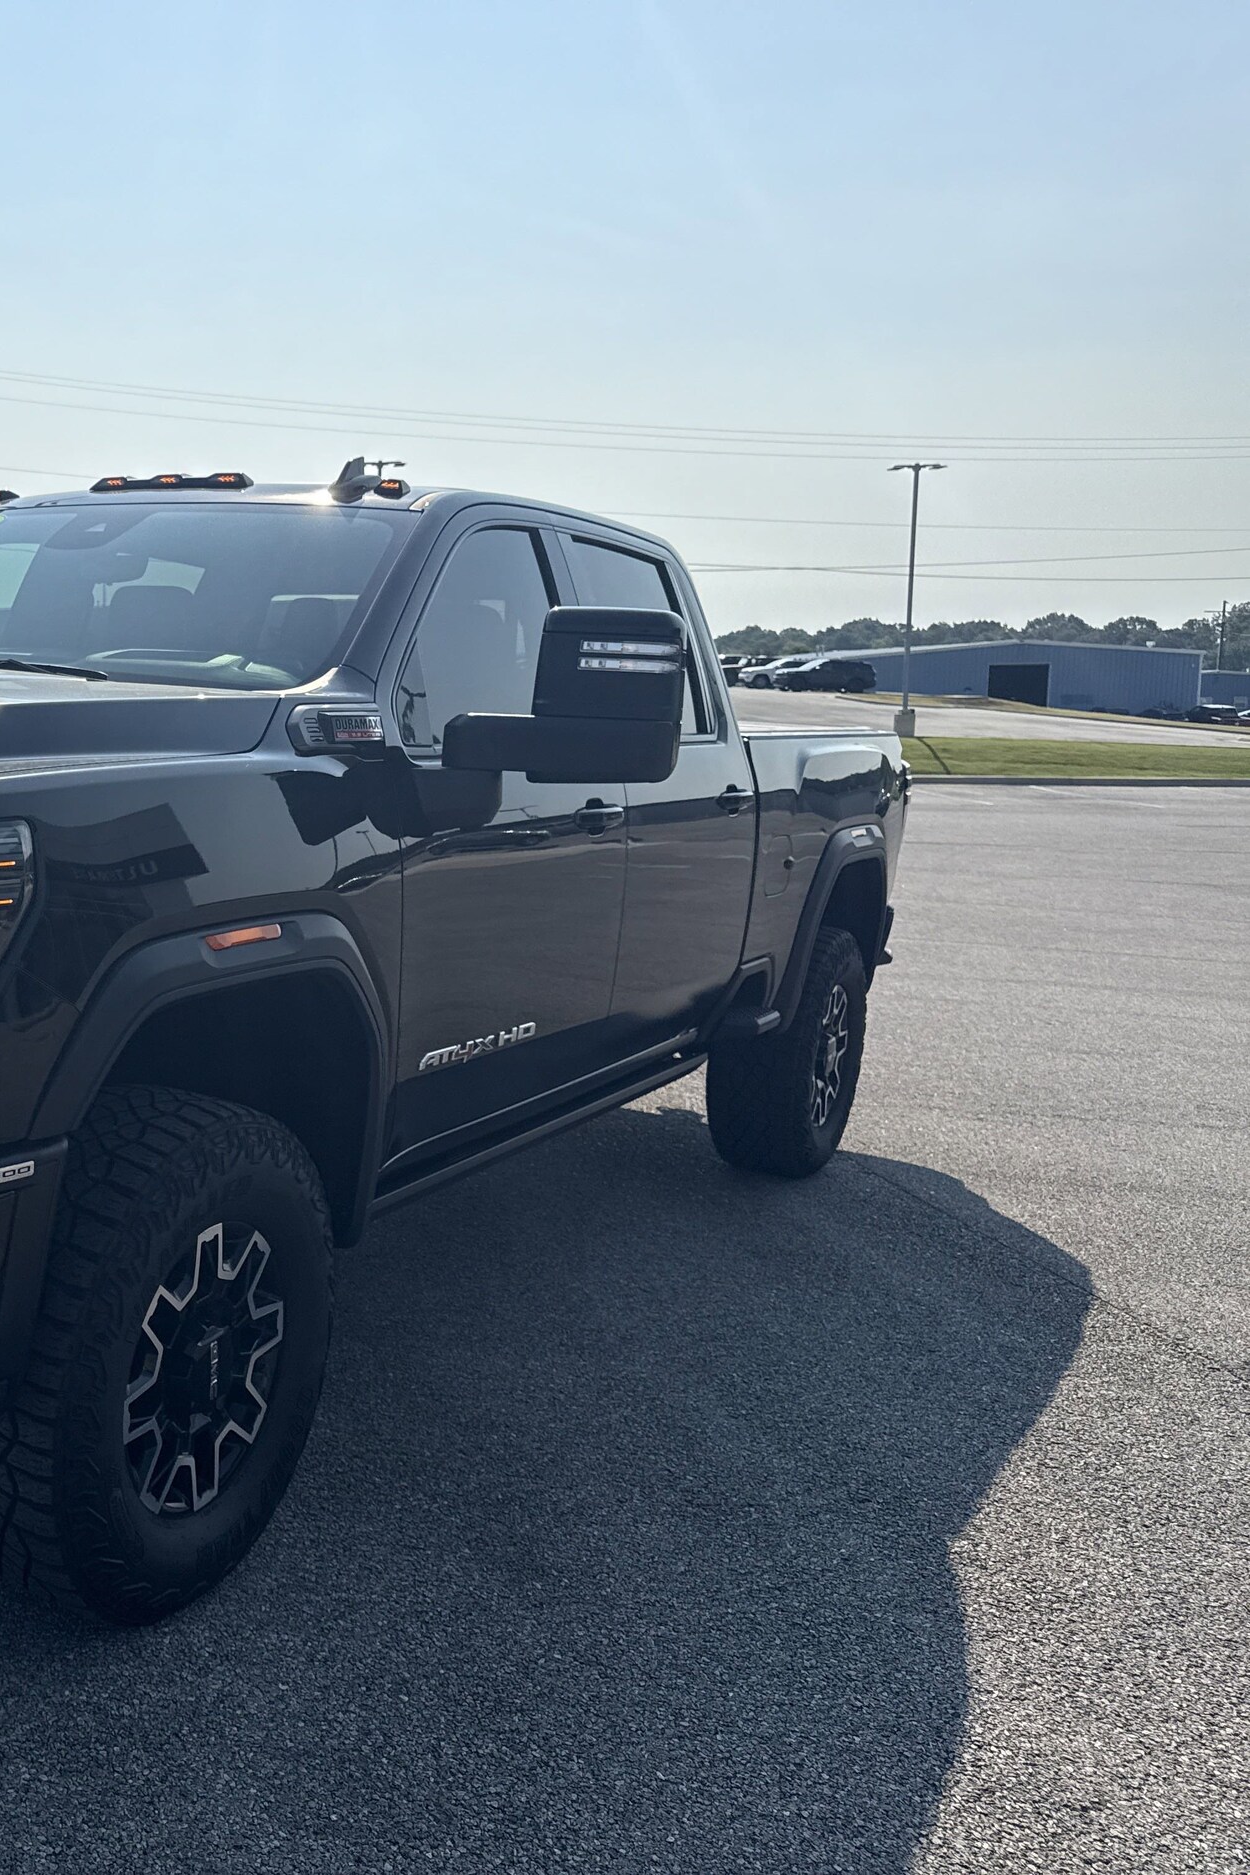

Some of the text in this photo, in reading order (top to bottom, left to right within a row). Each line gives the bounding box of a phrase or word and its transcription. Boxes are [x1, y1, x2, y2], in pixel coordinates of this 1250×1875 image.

[335, 718, 380, 730] DURAMAX
[418, 1021, 537, 1071] AT4X HD
